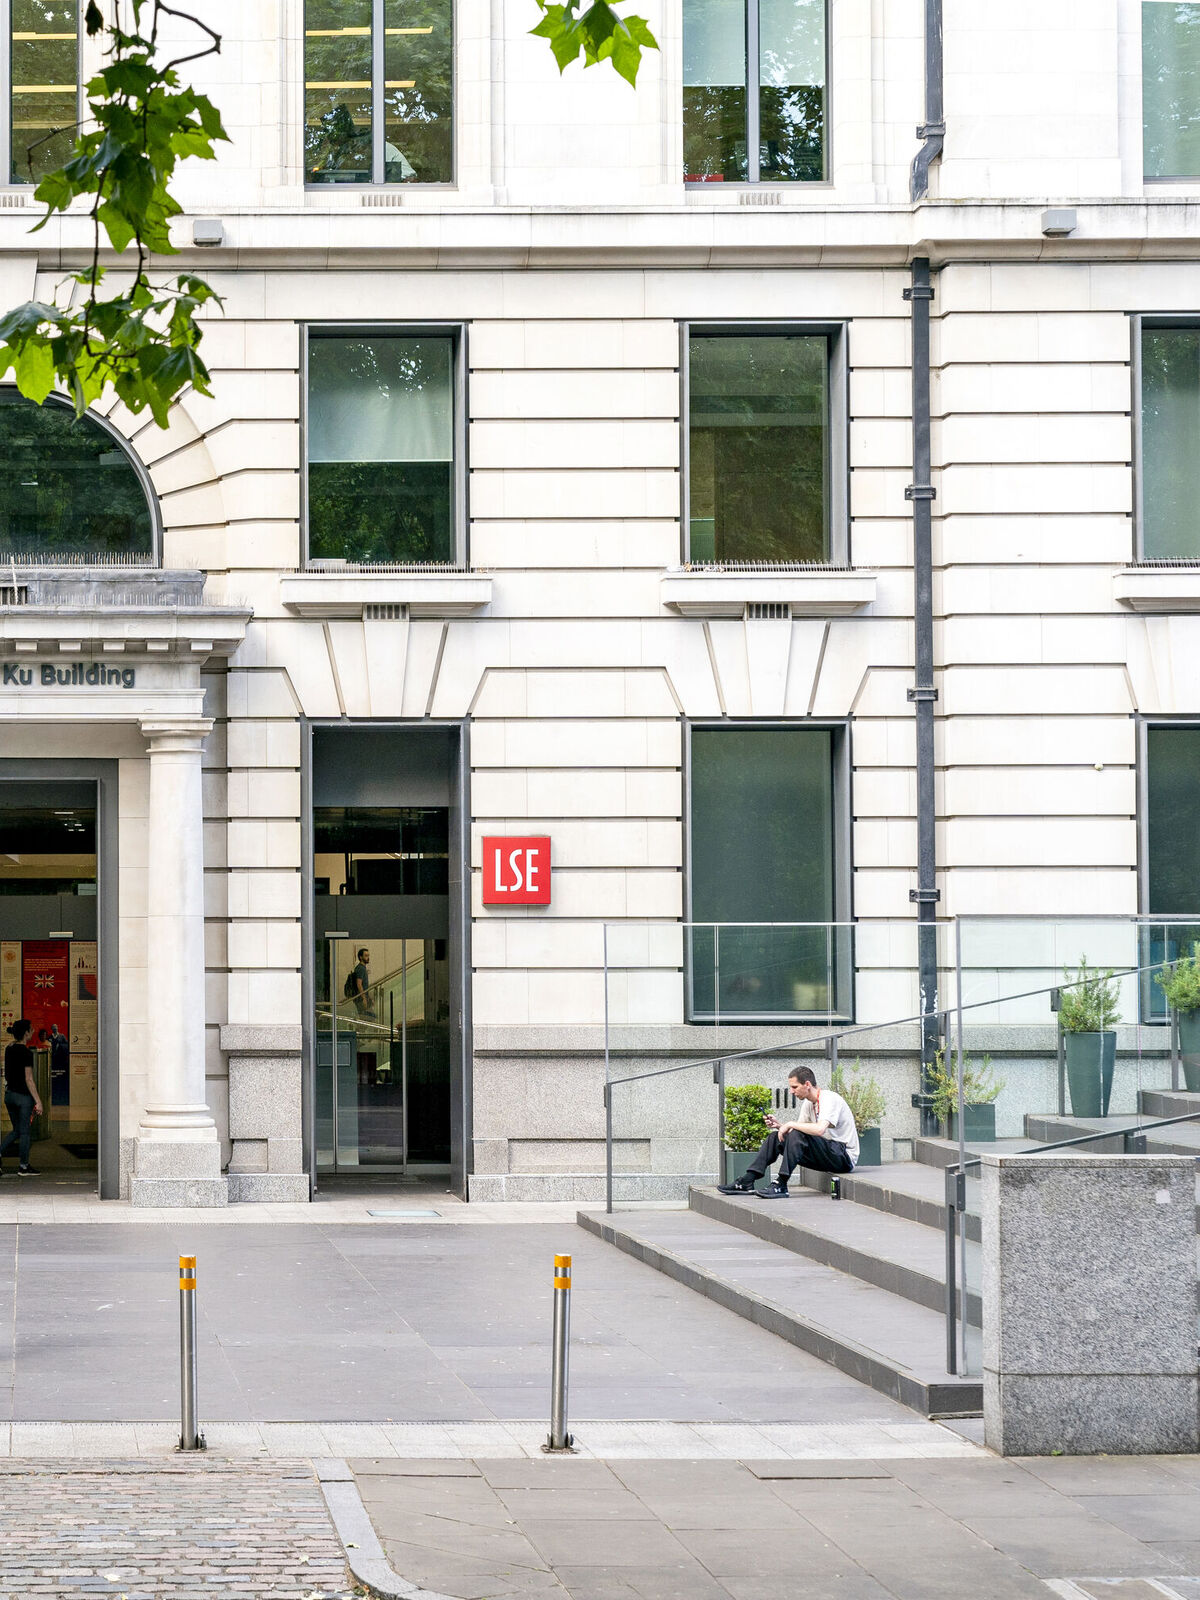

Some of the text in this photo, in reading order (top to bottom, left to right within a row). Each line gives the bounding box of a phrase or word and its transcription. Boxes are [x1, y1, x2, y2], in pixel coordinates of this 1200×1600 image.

[3, 663, 32, 685] Ku
[40, 662, 136, 689] Building
[495, 848, 539, 892] LSE
